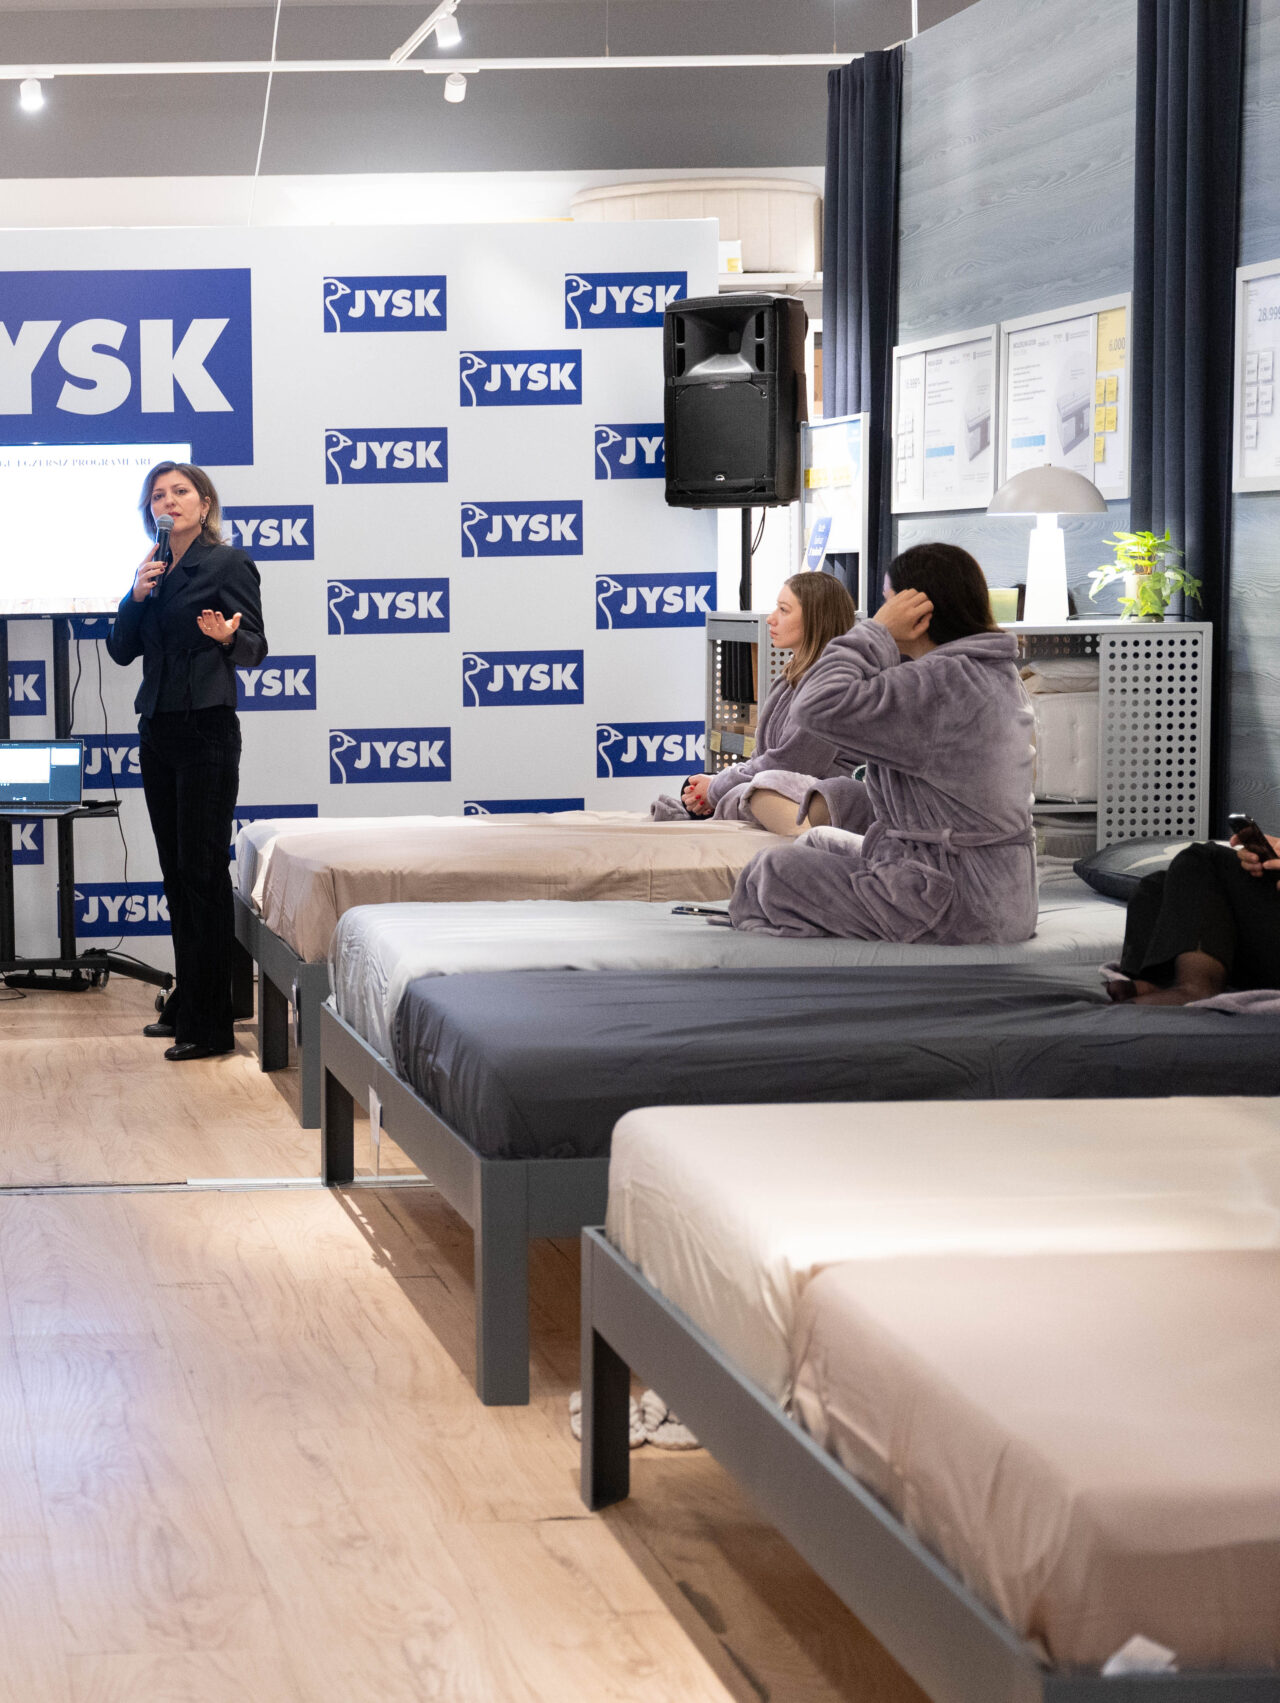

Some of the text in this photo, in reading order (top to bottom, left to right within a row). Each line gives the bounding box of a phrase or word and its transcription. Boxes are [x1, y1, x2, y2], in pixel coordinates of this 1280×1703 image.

[348, 289, 441, 317] JYSK
[590, 285, 681, 314] JYSK
[485, 363, 576, 391] JYSK
[350, 441, 442, 469] JYSK
[619, 437, 665, 464] JY
[486, 514, 577, 542] JYSK
[352, 592, 444, 619] JYSK
[620, 586, 711, 614] JYSK
[236, 669, 311, 696] YSK
[487, 664, 578, 692] JYSK
[85, 747, 141, 775] JYS
[354, 741, 445, 769] JYSK
[621, 735, 705, 763] JYSK
[82, 895, 170, 923] JYSK
